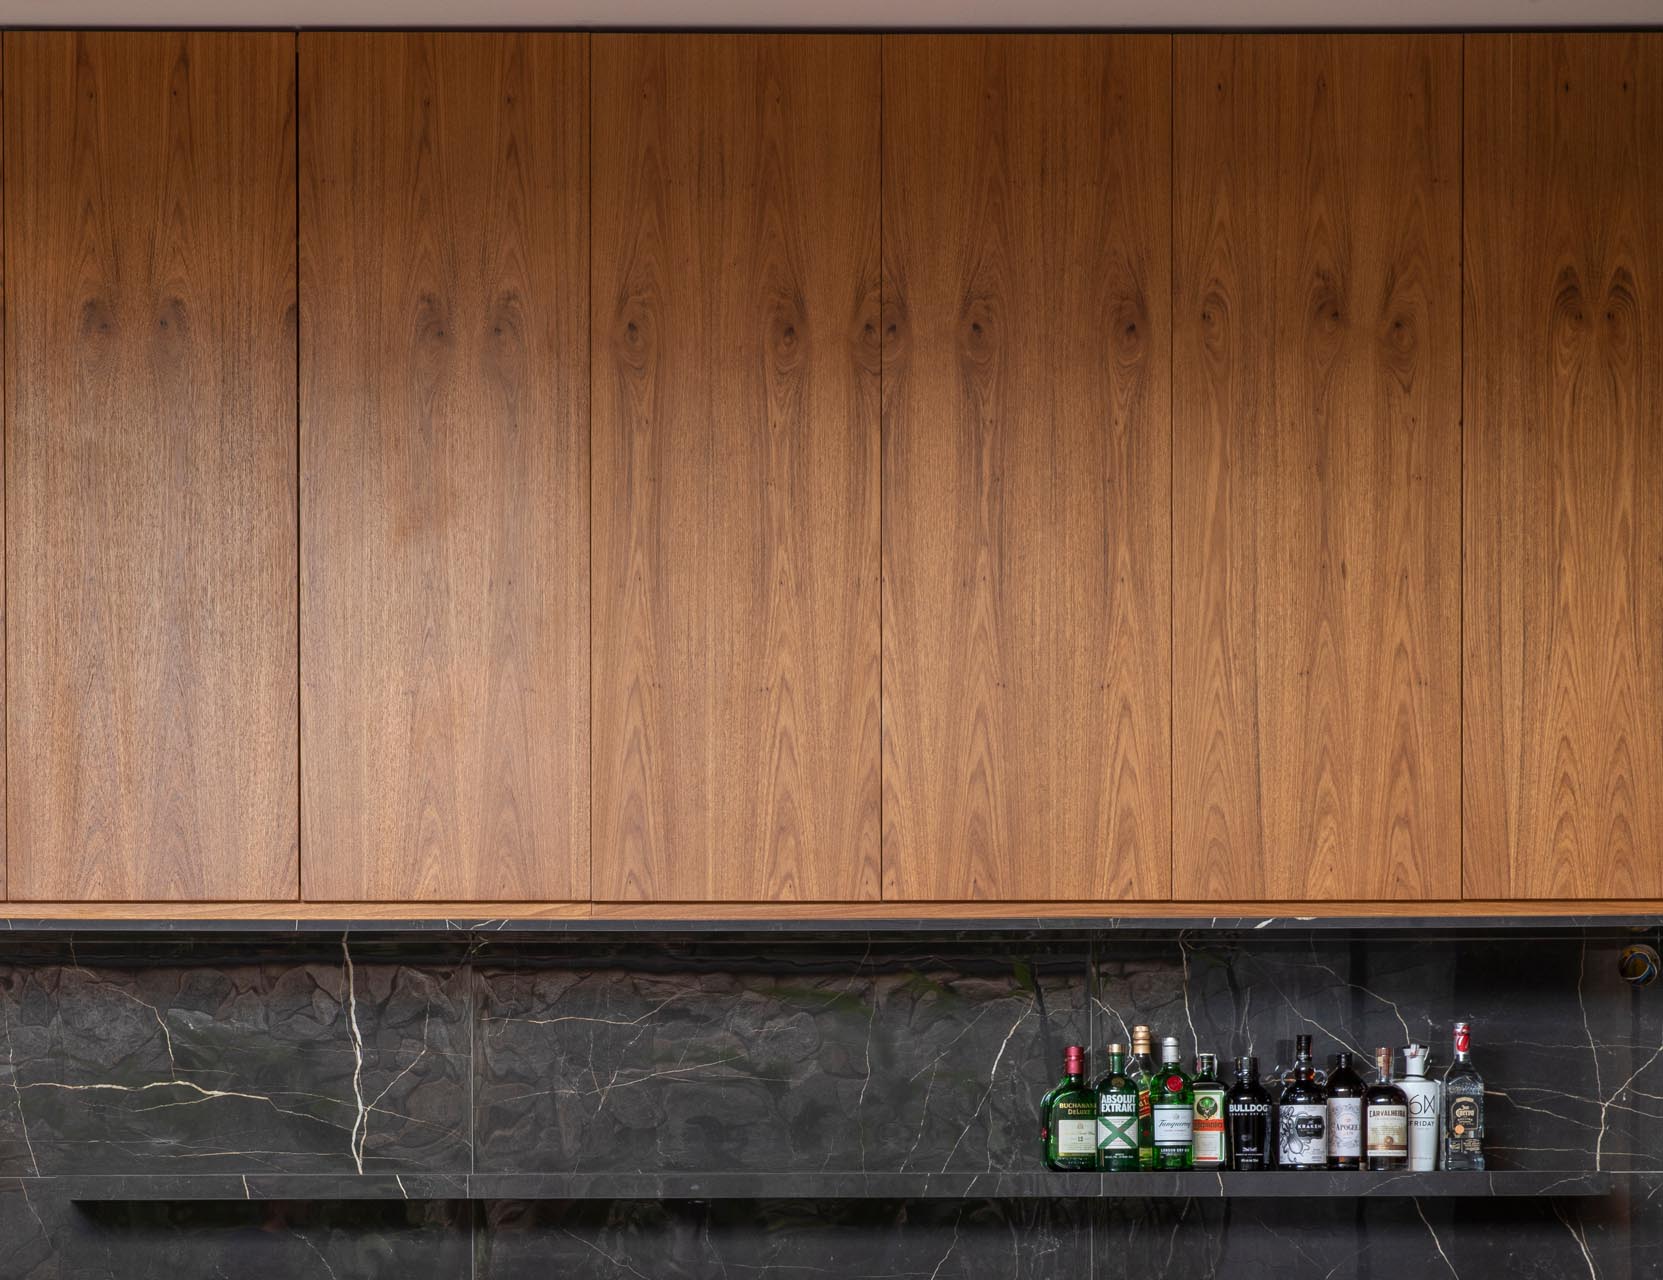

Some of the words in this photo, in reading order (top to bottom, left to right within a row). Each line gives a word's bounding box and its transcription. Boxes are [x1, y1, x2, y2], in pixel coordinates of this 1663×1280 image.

[1101, 1094, 1136, 1104] ABSOLUT
[1101, 1103, 1136, 1113] EXTRAKT
[1229, 1104, 1268, 1112] BULLDOG
[1159, 1119, 1191, 1129] Tanqueray
